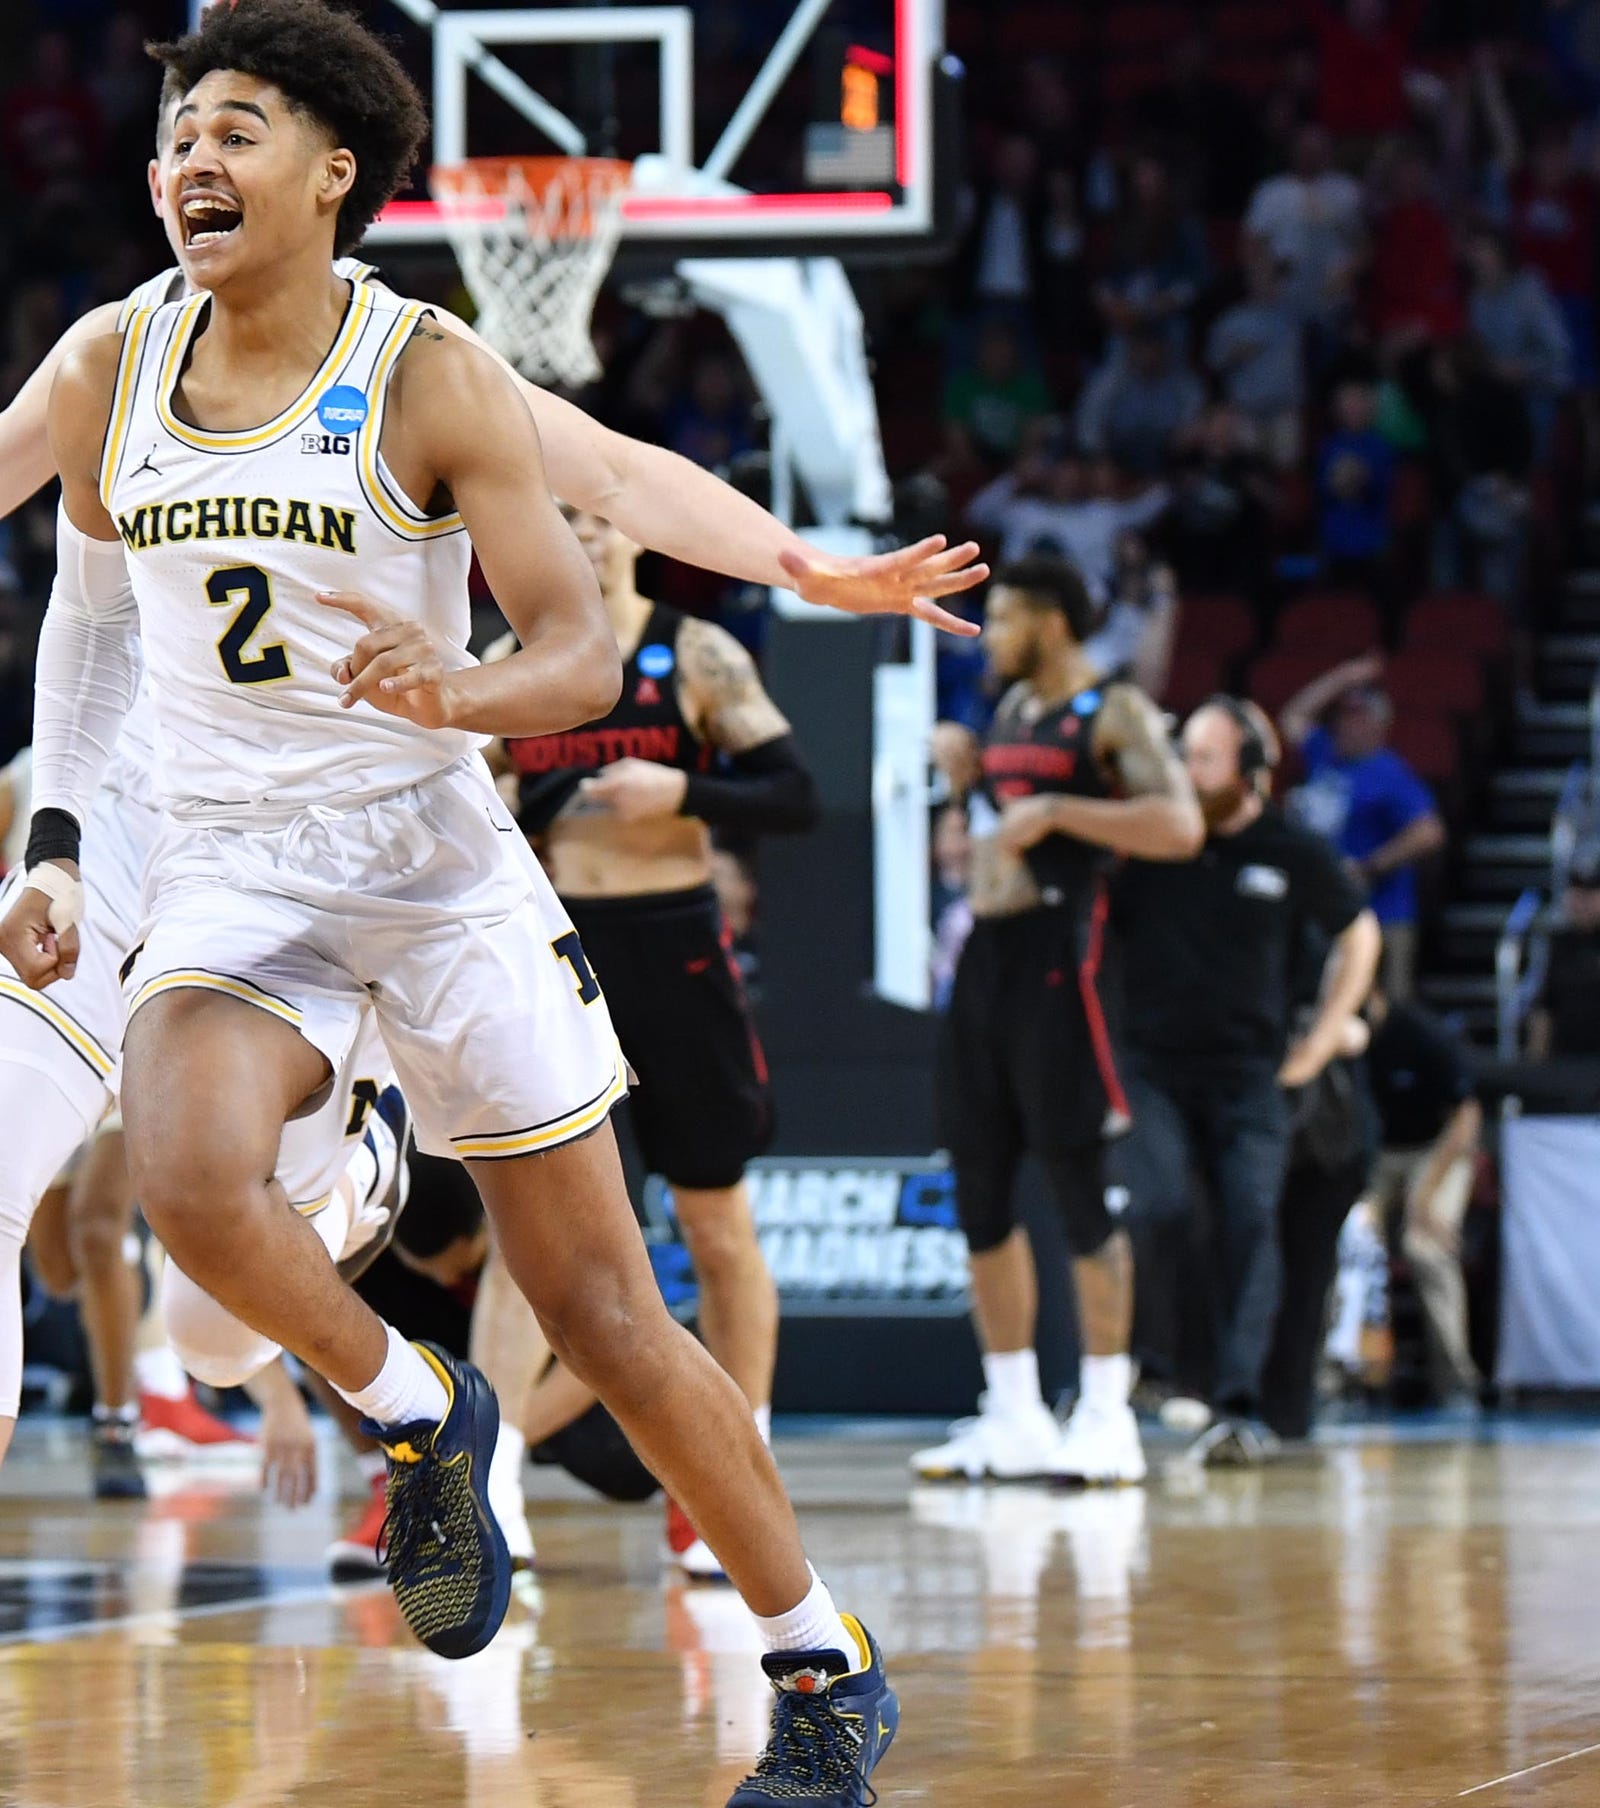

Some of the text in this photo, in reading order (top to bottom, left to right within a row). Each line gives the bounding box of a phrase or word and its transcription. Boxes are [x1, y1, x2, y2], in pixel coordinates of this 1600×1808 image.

[322, 405, 366, 424] NCAA
[118, 495, 357, 556] MICHIGAN
[203, 562, 294, 686] 2
